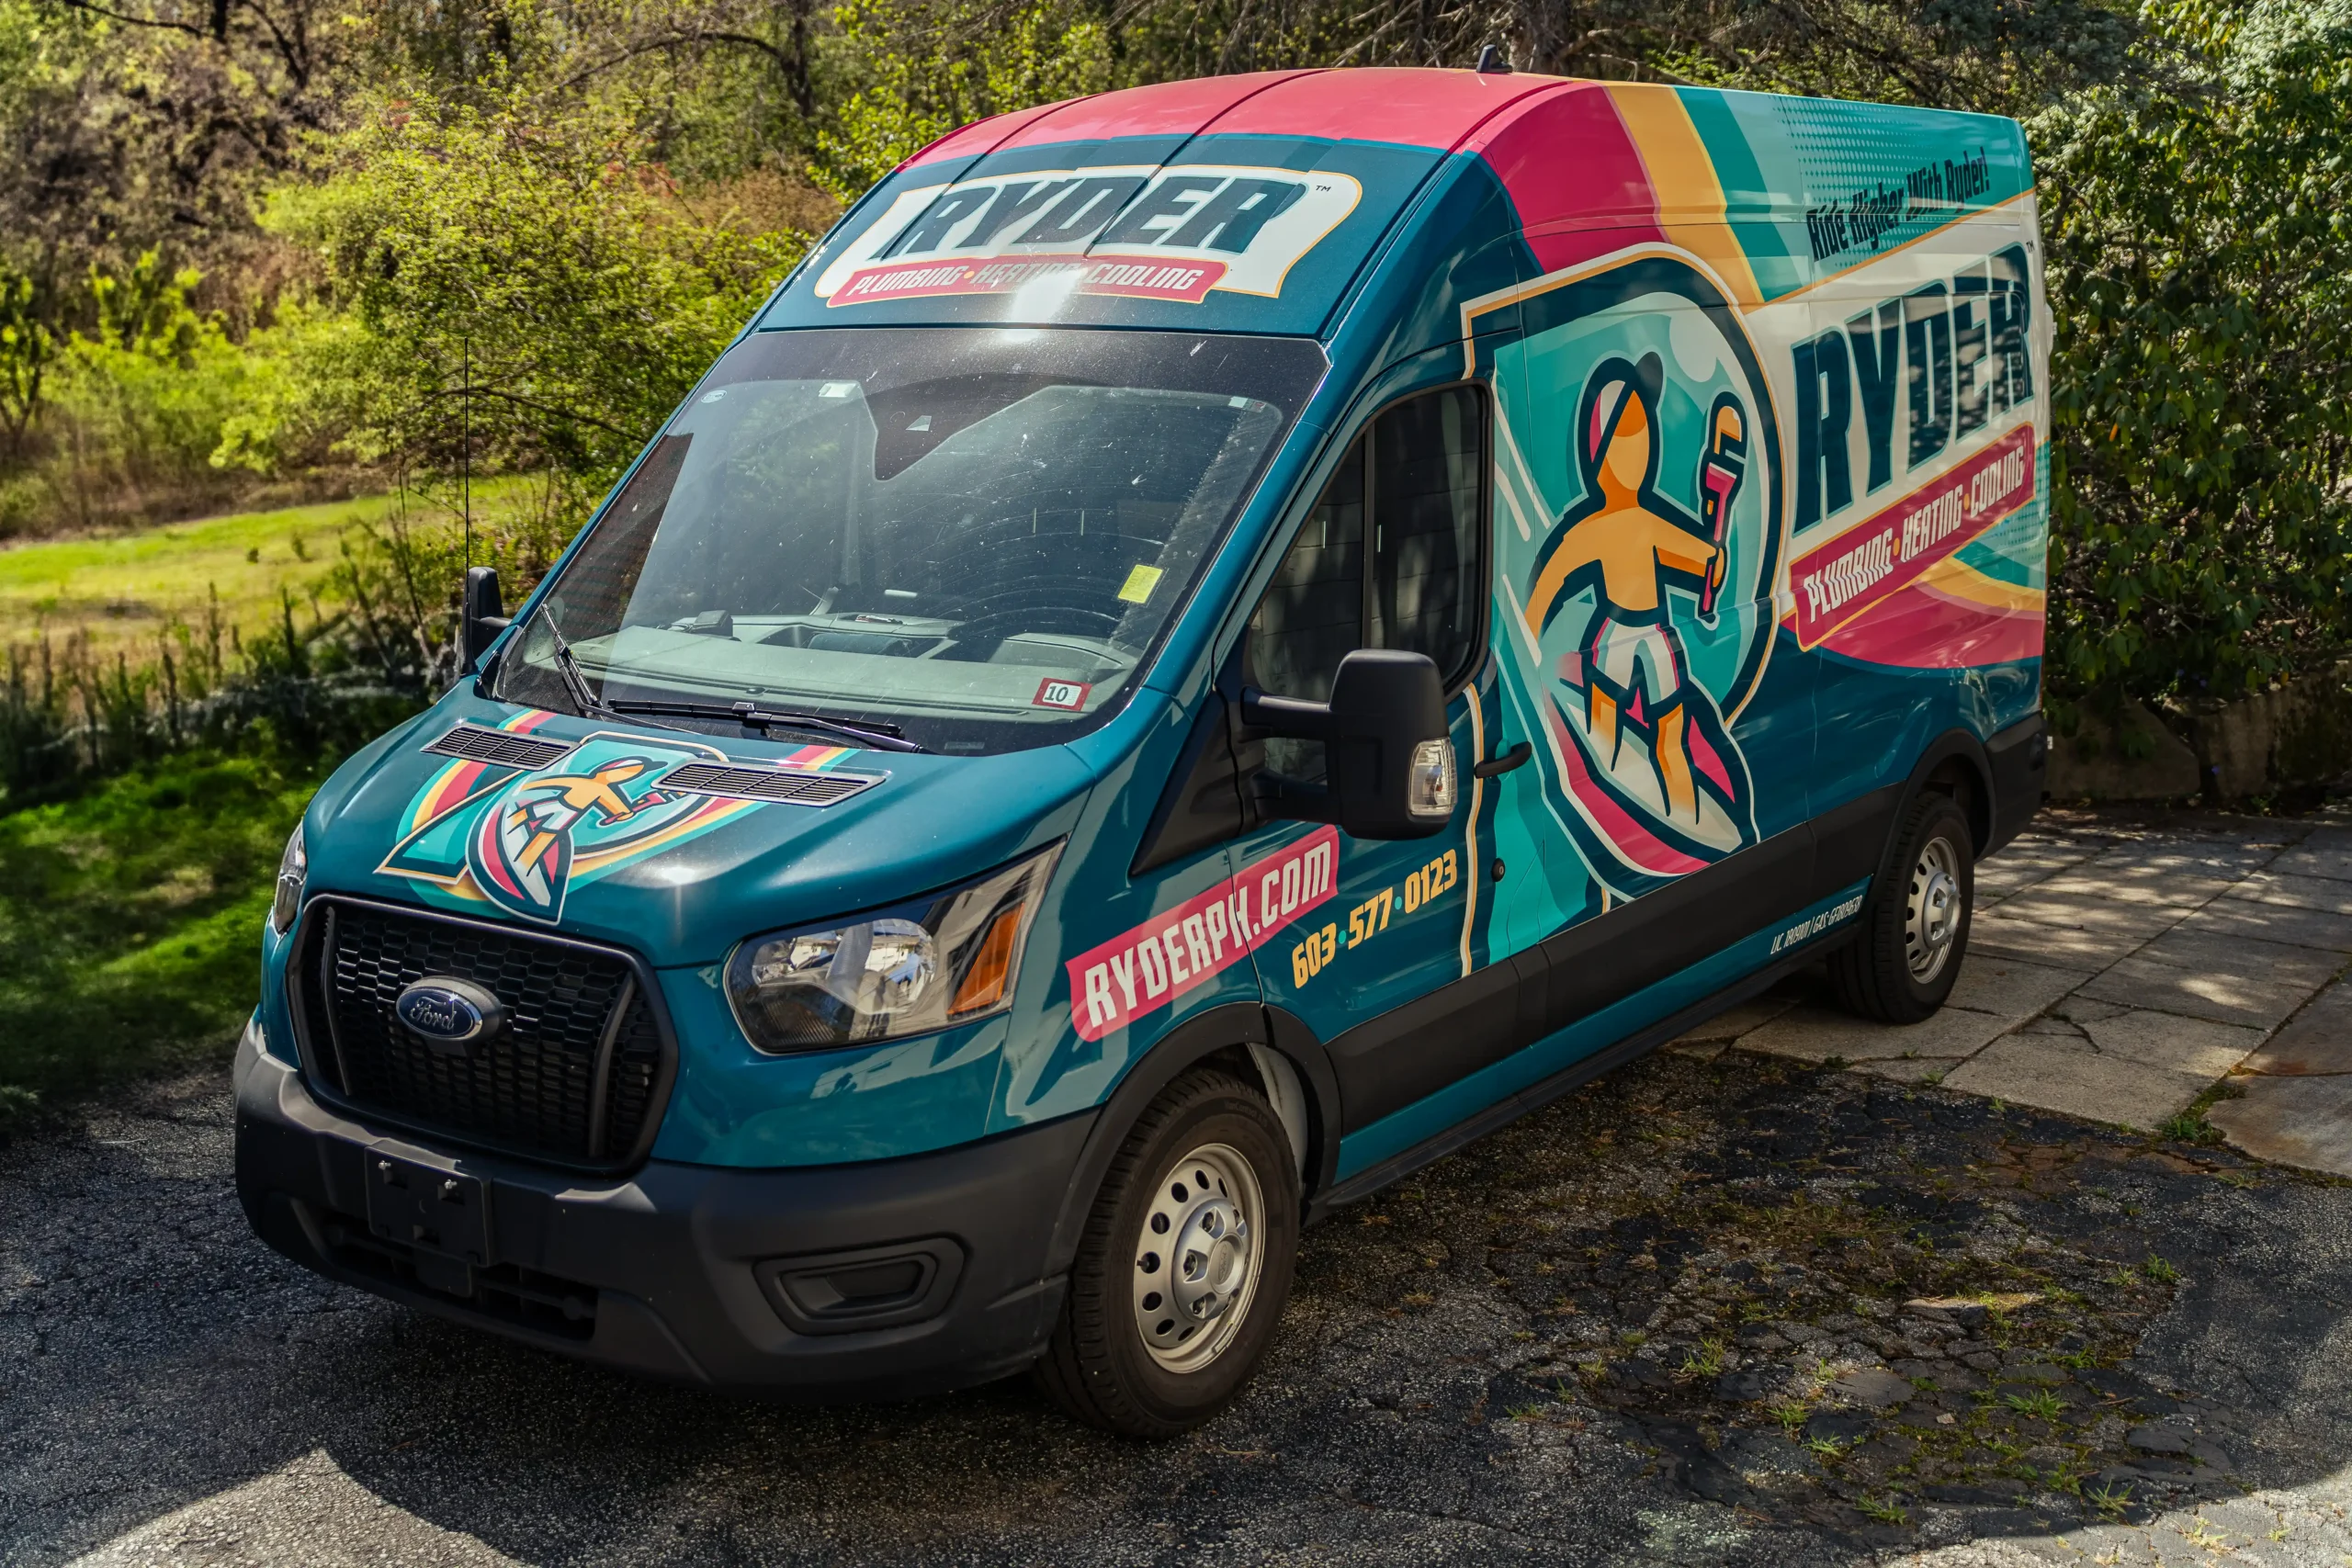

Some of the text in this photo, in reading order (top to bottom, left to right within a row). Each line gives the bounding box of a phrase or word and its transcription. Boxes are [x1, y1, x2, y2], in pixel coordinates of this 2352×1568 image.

[865, 175, 1310, 262] RYDER
[1806, 146, 1990, 263] Ride Higher With Ryder!
[846, 265, 969, 297] PLUMBING
[1084, 264, 1204, 290] COOLING
[1791, 241, 2035, 538] RYDER
[1803, 446, 2024, 623] PLUMBING HEATING COOLING
[1045, 685, 1069, 702] 10
[1085, 840, 1331, 1028] RYDERPH.COM
[1292, 849, 1457, 989] 603 577 0123
[410, 996, 458, 1031] Ford
